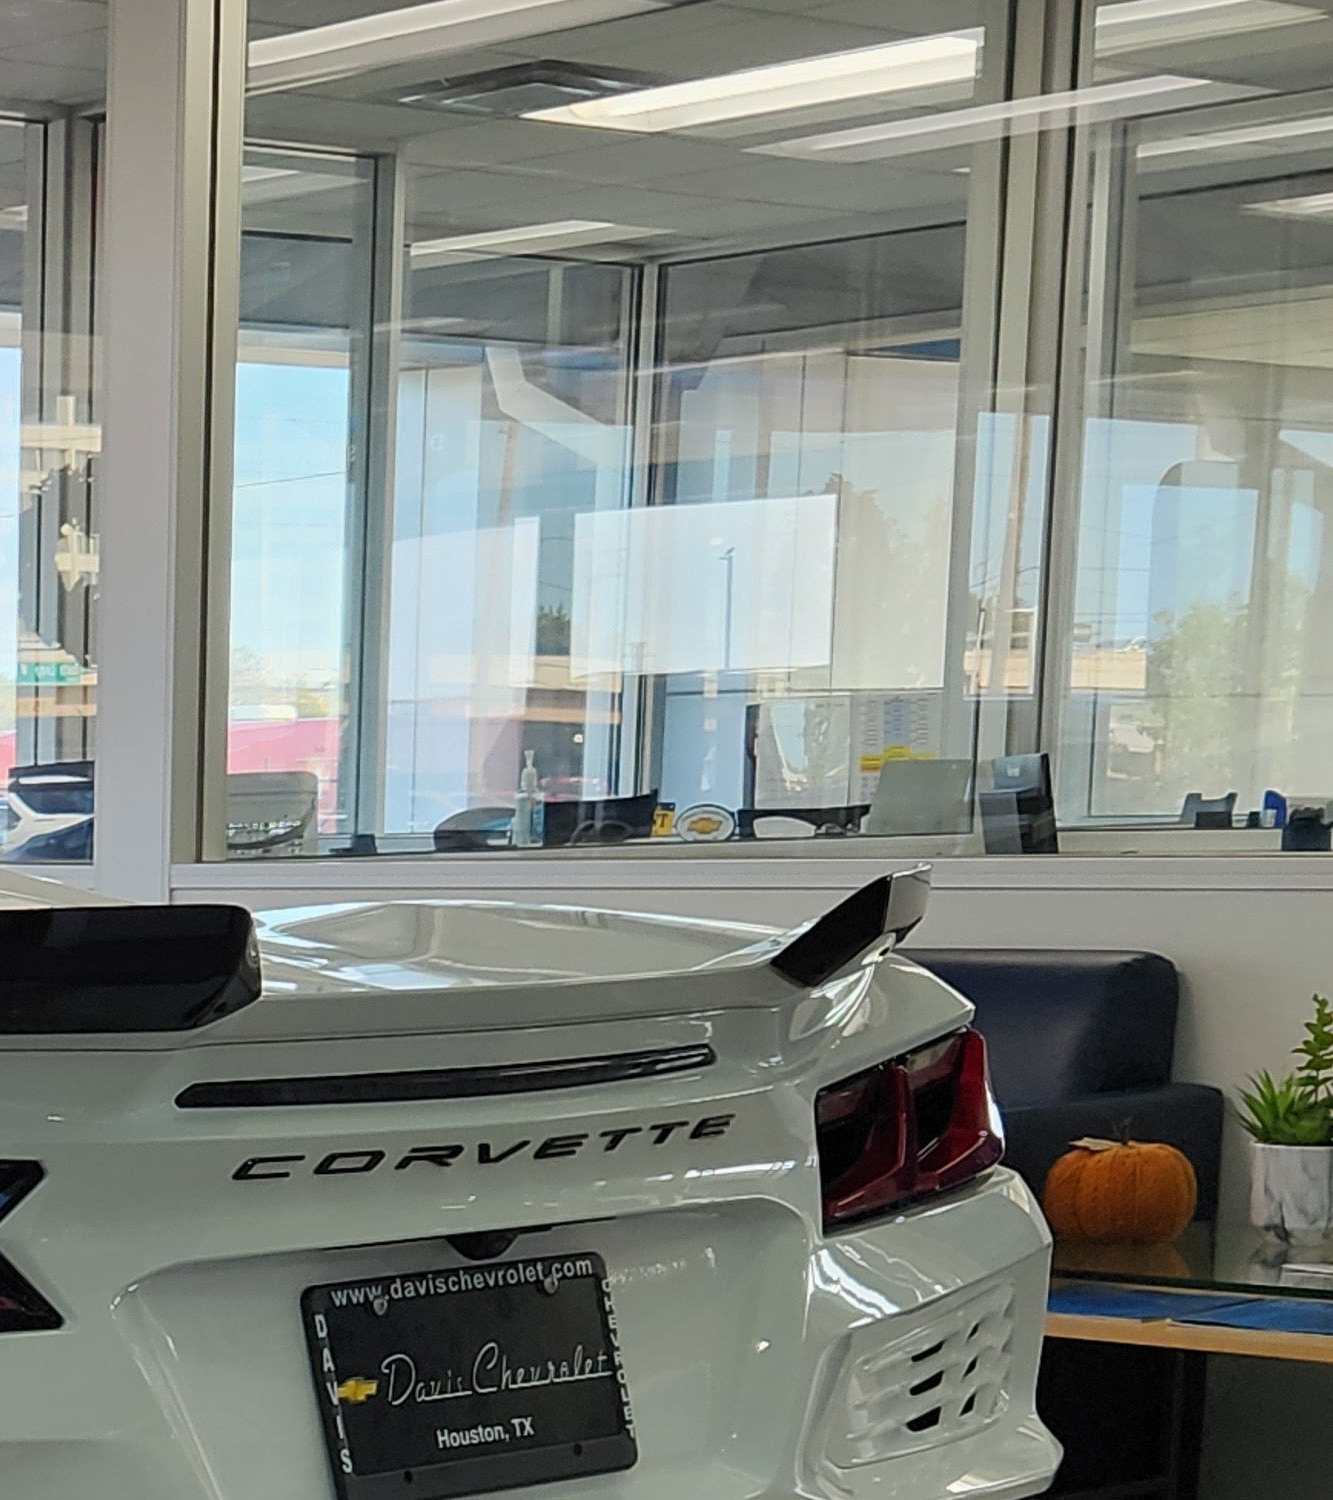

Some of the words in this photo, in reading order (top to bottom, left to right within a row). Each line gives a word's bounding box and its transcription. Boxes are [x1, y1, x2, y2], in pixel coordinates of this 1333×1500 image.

[232, 1113, 736, 1181] CORVETTE
[330, 1257, 594, 1308] www.davischevrolet.com
[314, 1313, 354, 1474] DAVIS
[380, 1353, 473, 1406] Davis
[473, 1342, 614, 1394] Chevrolet
[436, 1422, 510, 1449] Houston,
[511, 1415, 535, 1438] TX
